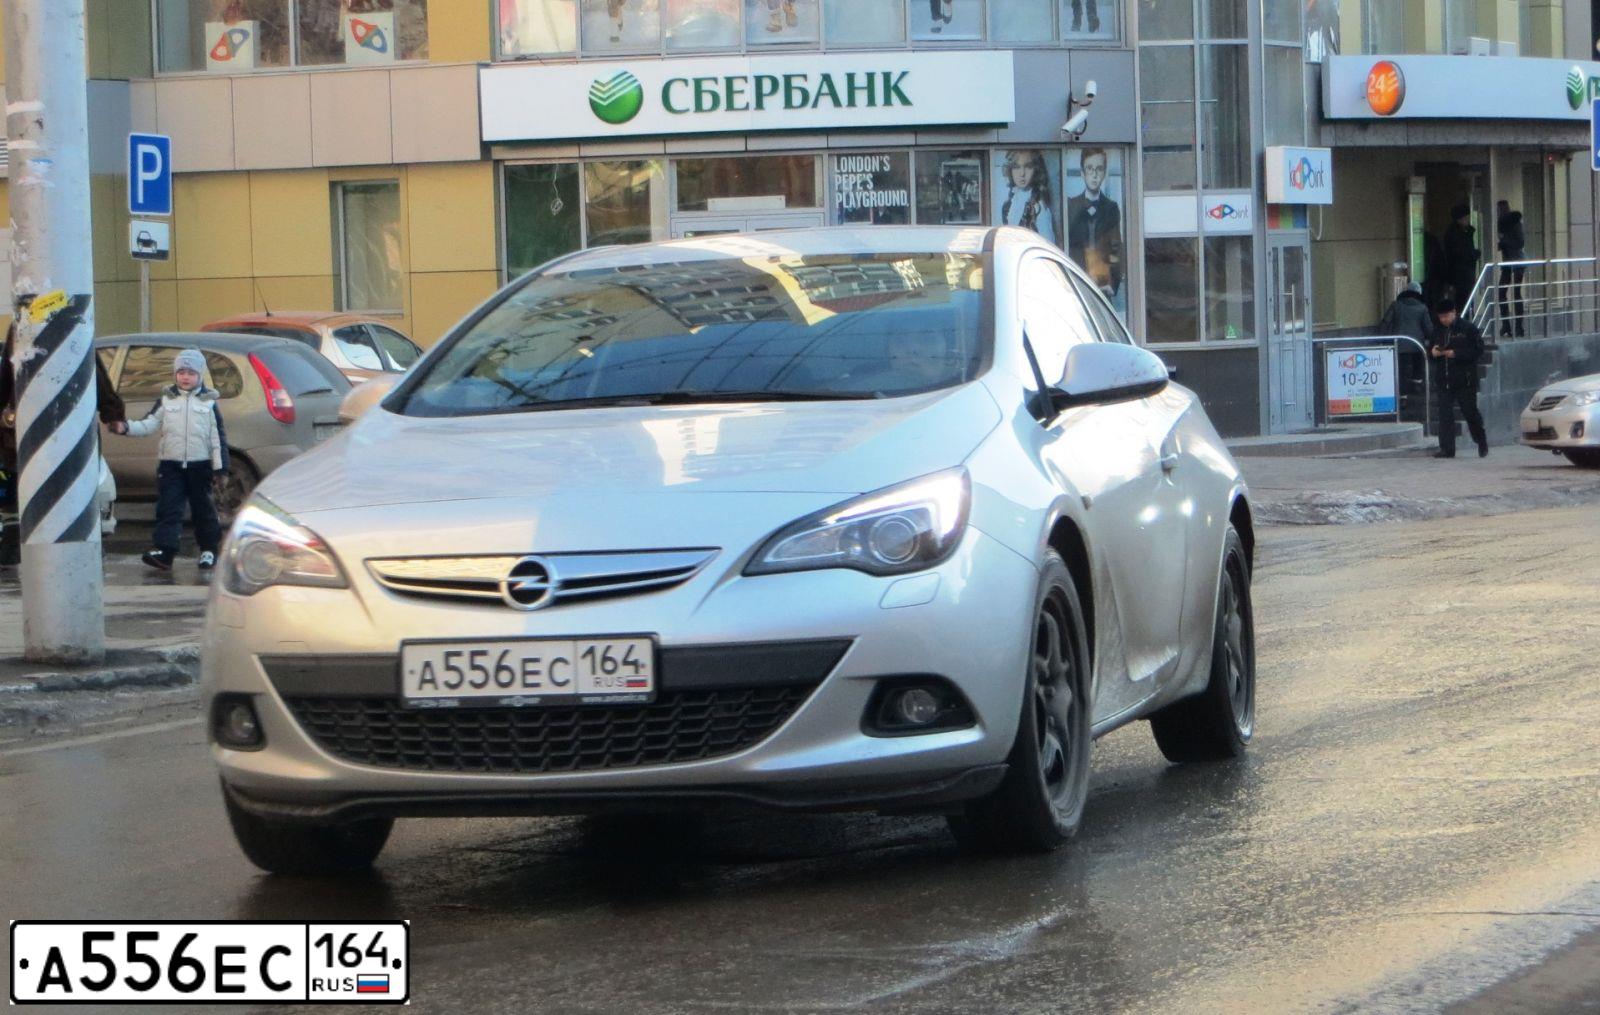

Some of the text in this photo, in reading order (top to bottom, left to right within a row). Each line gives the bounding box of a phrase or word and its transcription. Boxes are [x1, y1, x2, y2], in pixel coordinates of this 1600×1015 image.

[661, 70, 914, 115] СБЕРБАНК
[1368, 73, 1386, 93] 24
[136, 143, 163, 204] P
[834, 155, 891, 173] LONDON'S
[834, 173, 875, 191] PEPE'S
[418, 643, 641, 690] A556EC 164
[593, 676, 626, 688] RUS
